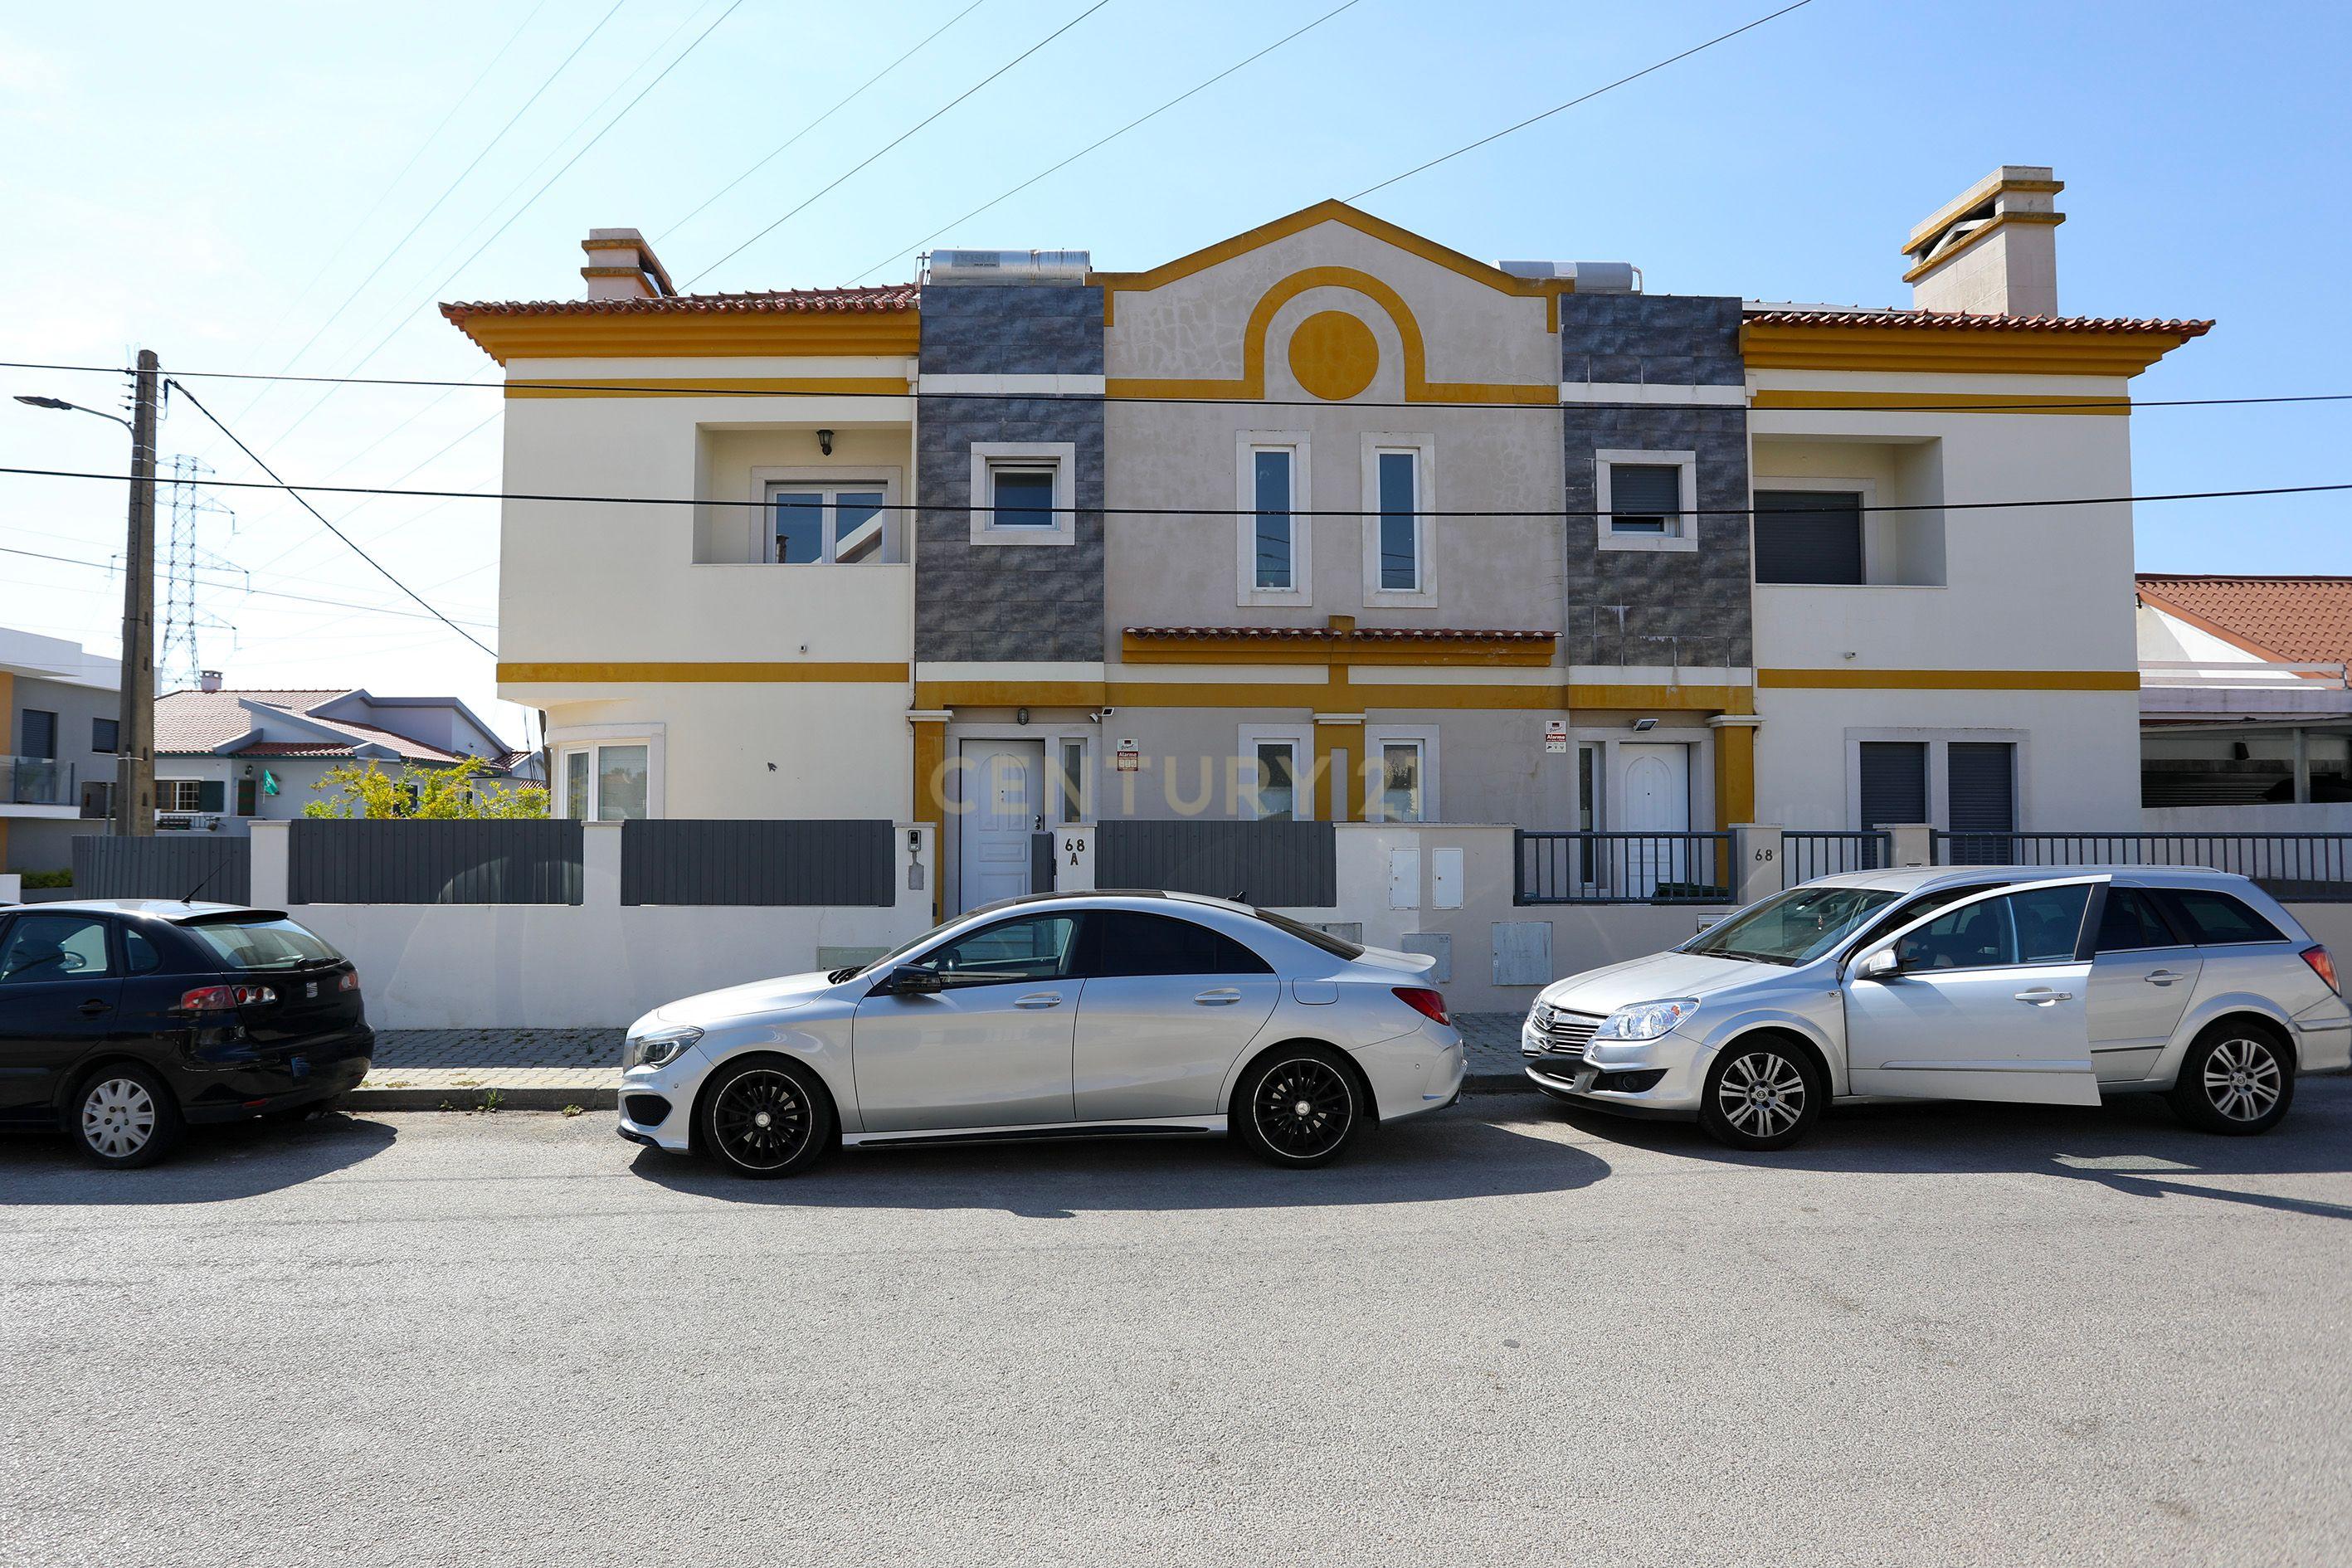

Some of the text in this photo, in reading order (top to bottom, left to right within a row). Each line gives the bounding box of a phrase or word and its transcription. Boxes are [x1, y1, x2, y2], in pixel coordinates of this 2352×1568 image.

[1065, 838, 1085, 852] 68
[1070, 852, 1079, 865] A
[1755, 848, 1773, 861] 68
